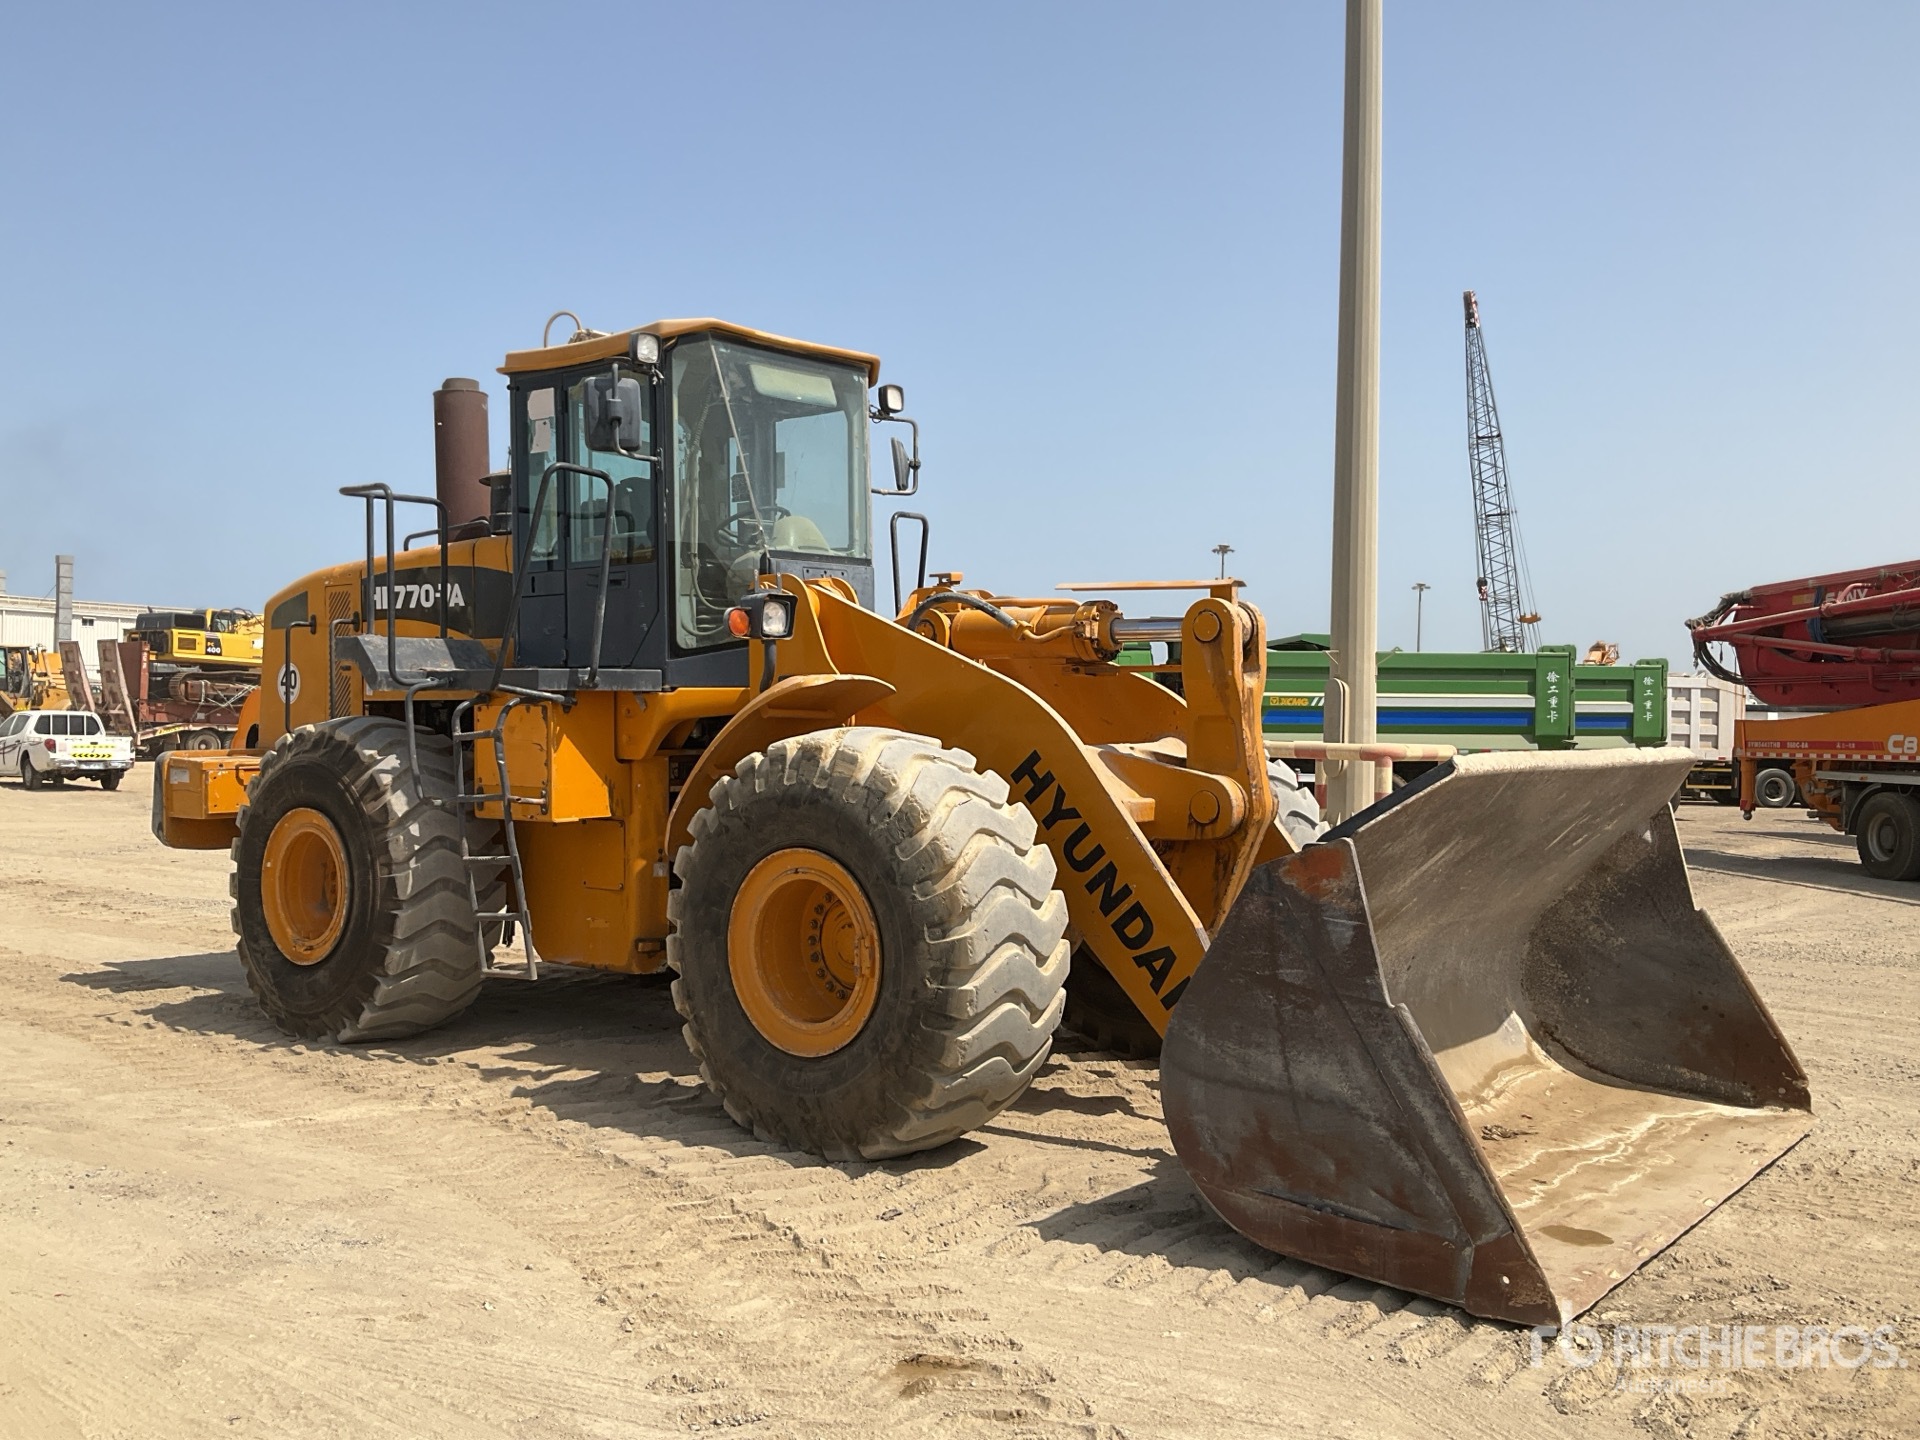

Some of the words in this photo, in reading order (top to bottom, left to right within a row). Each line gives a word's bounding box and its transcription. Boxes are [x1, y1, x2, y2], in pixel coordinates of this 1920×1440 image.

[281, 670, 297, 689] 40
[1279, 697, 1309, 706] XCMG
[1546, 671, 1560, 724] 徐工重卡
[1643, 676, 1655, 722] 徐工重卡
